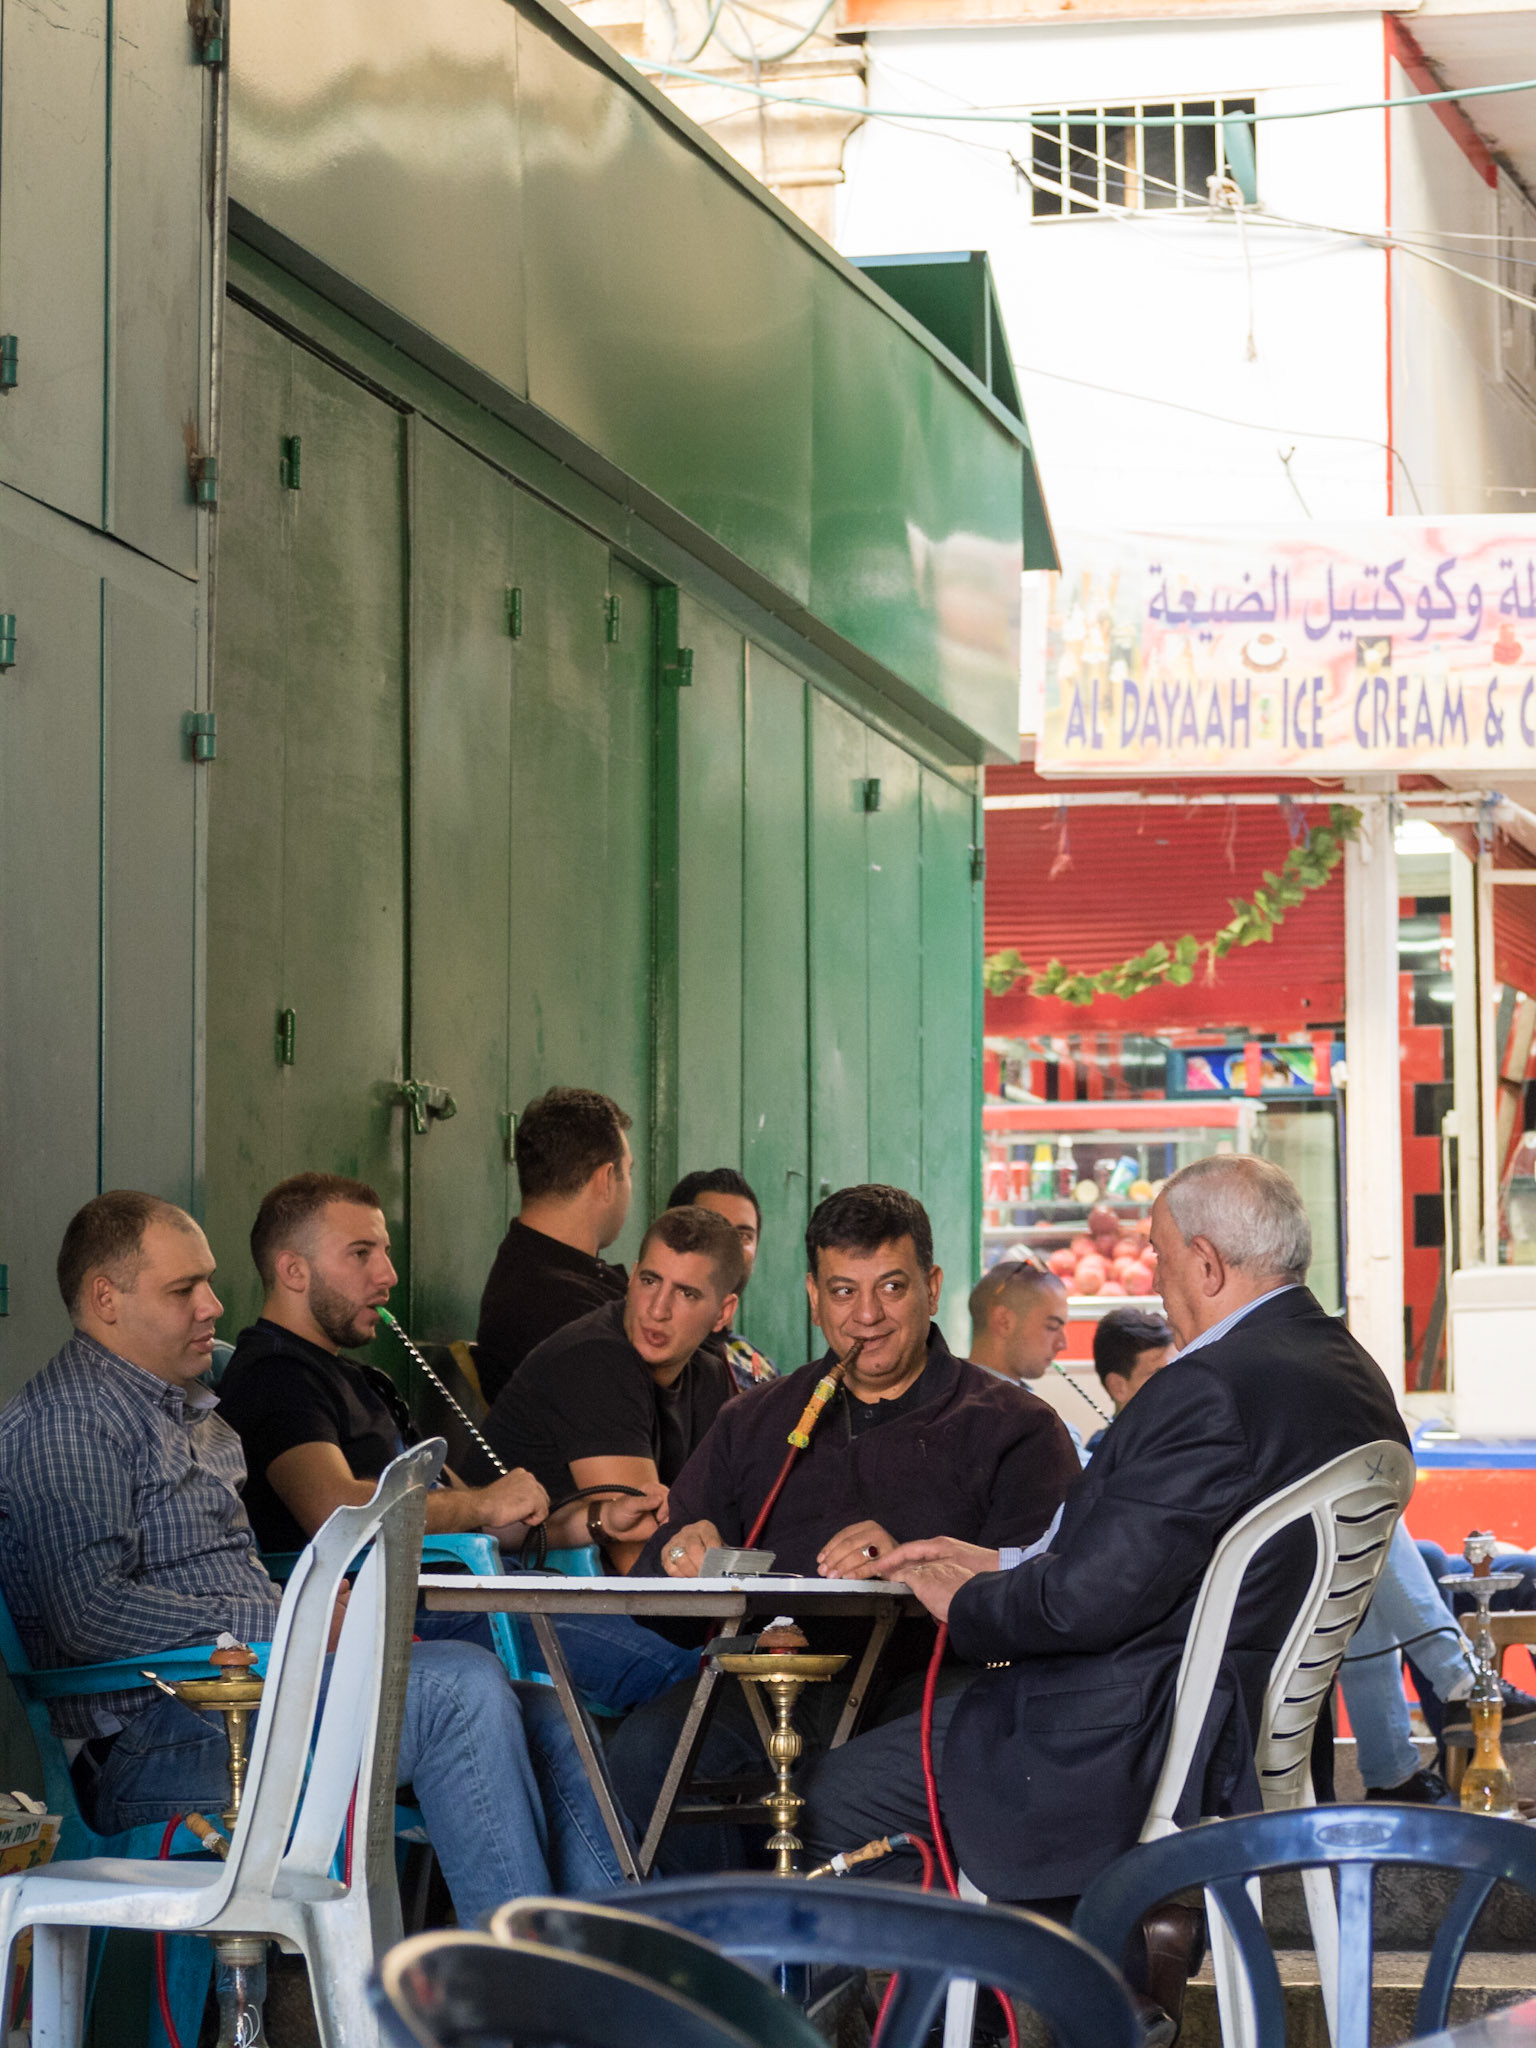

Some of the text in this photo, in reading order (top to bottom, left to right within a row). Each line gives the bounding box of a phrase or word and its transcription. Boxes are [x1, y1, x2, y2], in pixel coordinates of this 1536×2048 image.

[1148, 563, 1289, 642] الضيعة
[1065, 679, 1104, 749] AL
[1120, 678, 1251, 749] DAYAAH
[1282, 676, 1324, 749] ICE
[1354, 675, 1469, 749] CREAM
[1484, 675, 1504, 748] &
